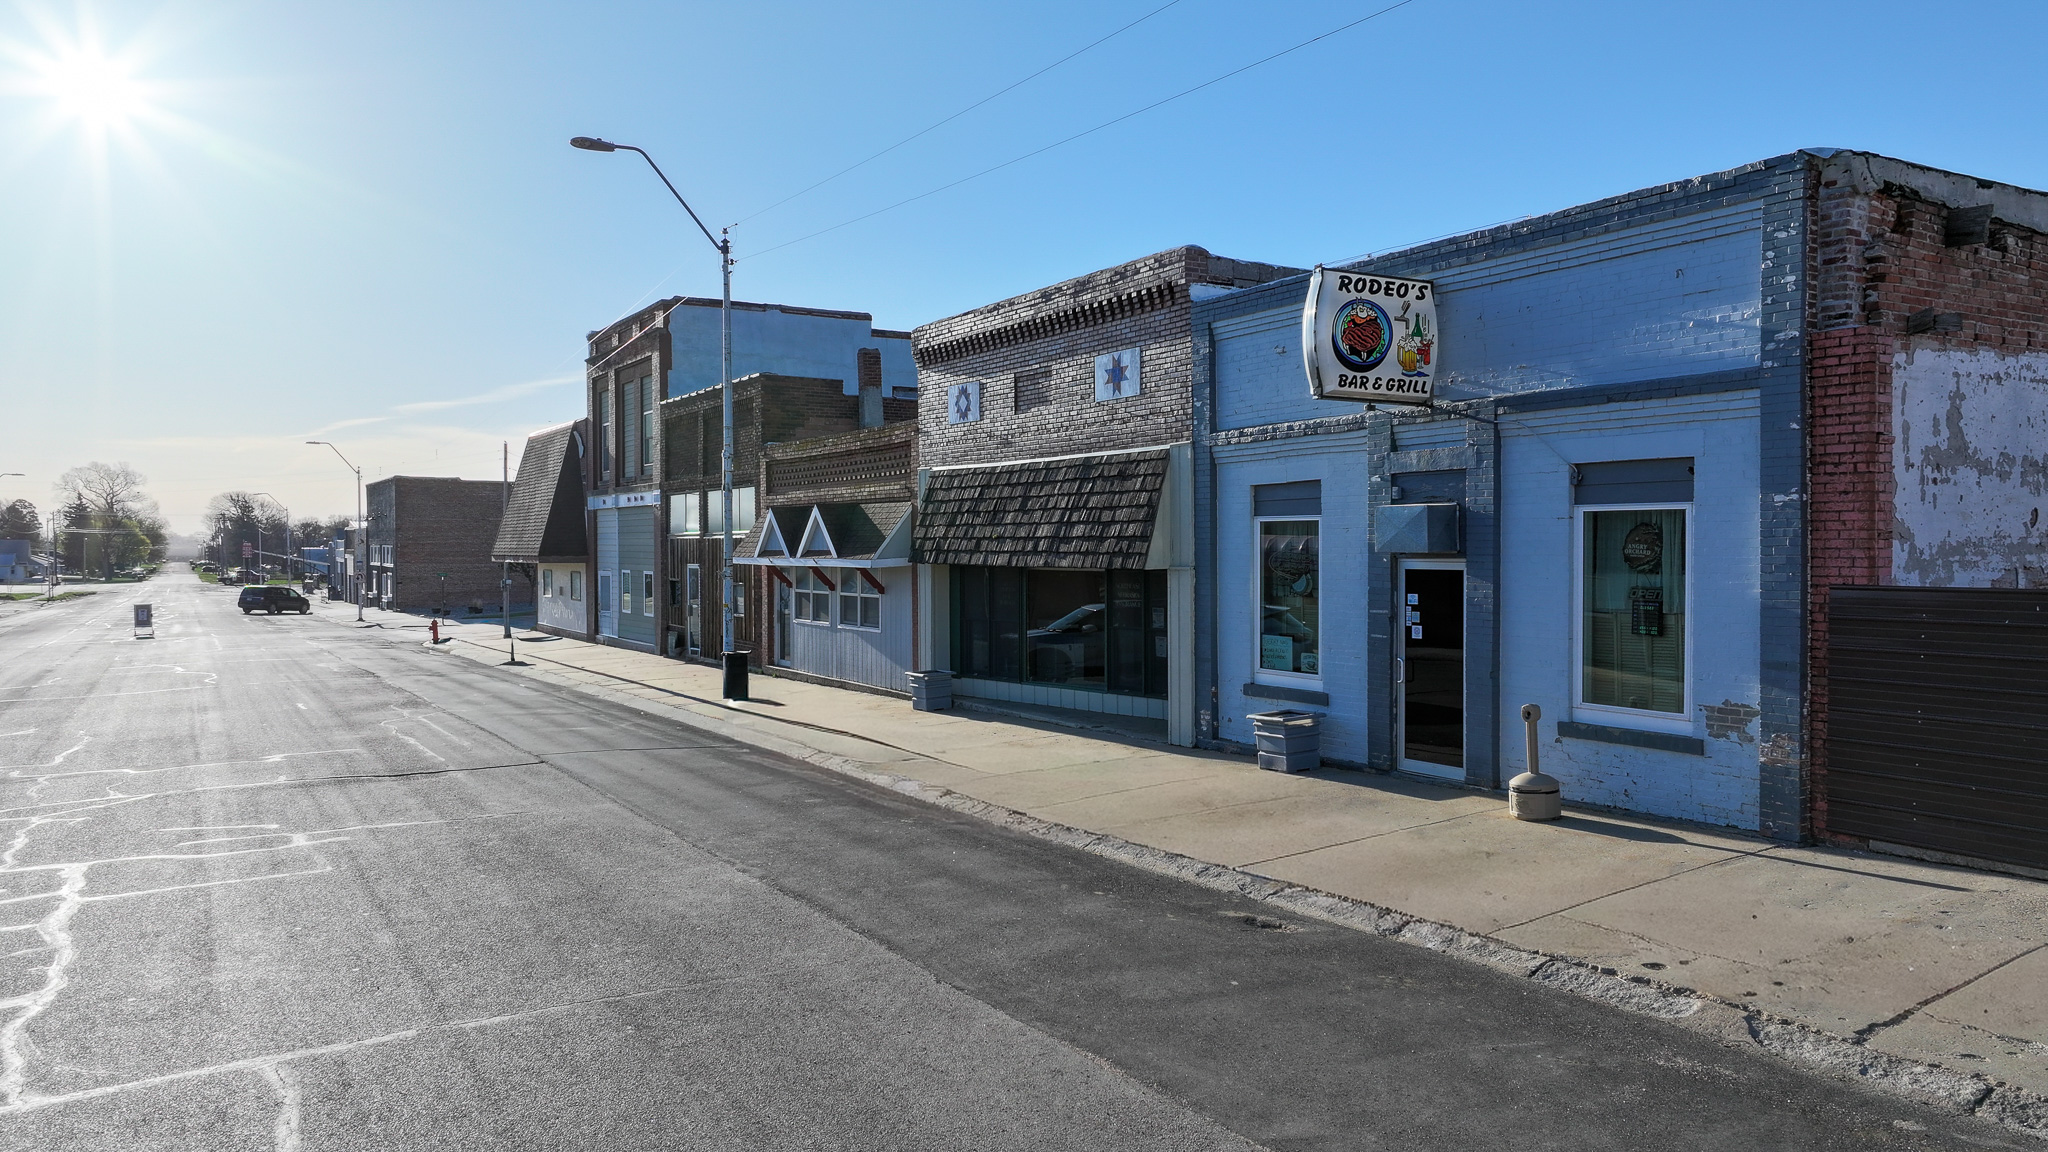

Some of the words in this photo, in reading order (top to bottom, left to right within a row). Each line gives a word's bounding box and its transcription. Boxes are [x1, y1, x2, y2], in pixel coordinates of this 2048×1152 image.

[1338, 276, 1429, 301] RODEO'S
[1338, 374, 1368, 391] BAR
[1372, 377, 1383, 390] &
[1386, 378, 1429, 394] GRILL
[1624, 548, 1651, 556] ORCHARD
[1629, 589, 1663, 599] OPEN
